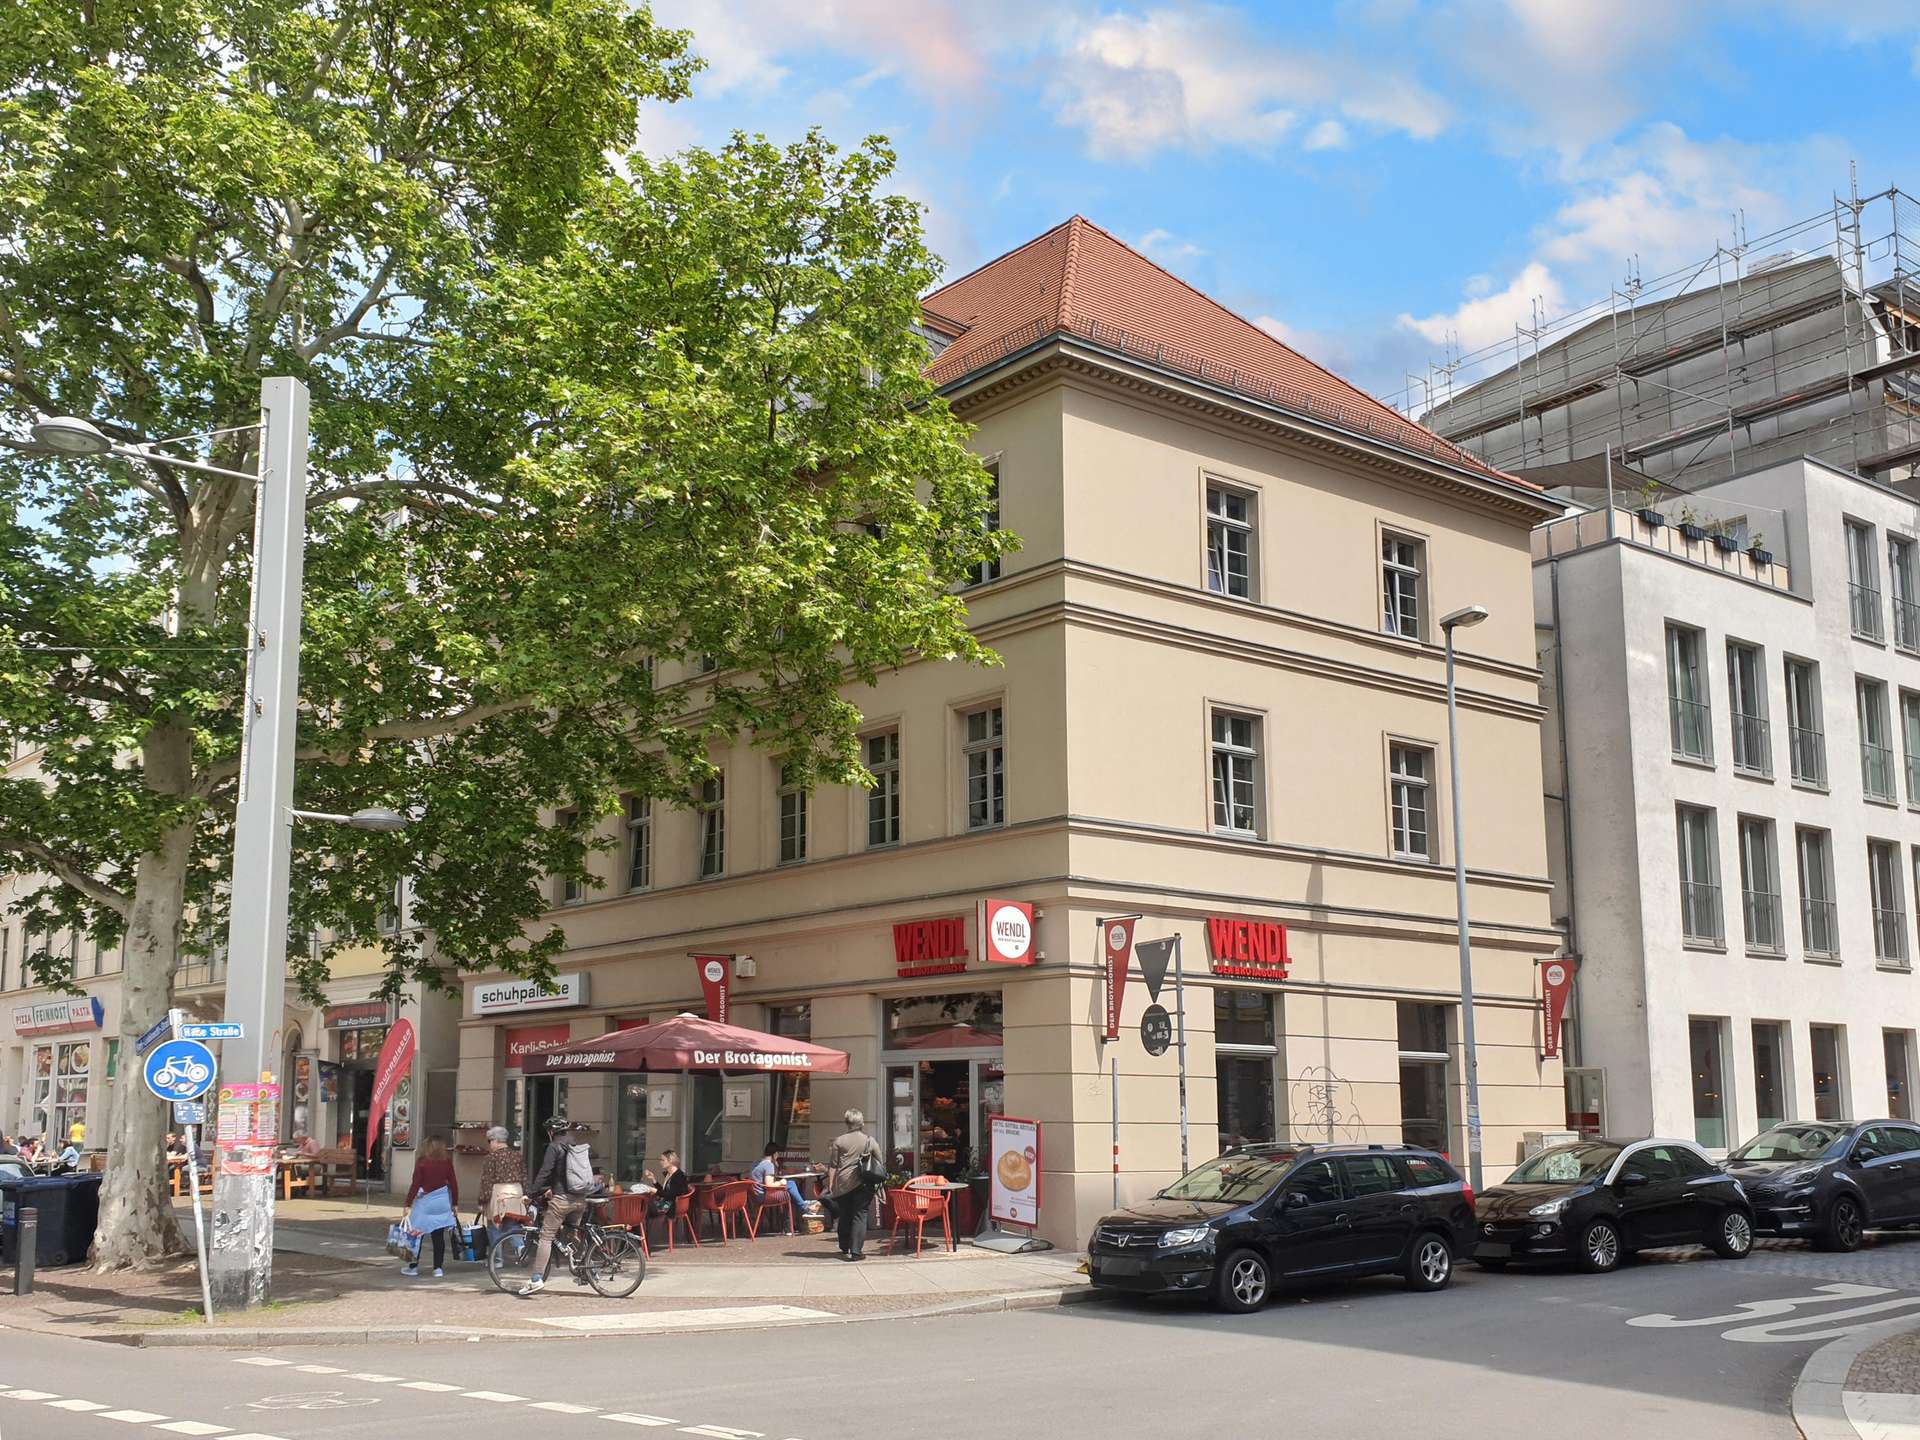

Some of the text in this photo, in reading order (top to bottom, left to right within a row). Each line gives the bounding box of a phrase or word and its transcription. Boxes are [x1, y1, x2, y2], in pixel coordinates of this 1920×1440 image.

[996, 921, 1026, 938] WENDL
[893, 917, 969, 962] WENDL
[1211, 916, 1292, 964] WENDL
[482, 983, 569, 1003] schuhpalee
[16, 1014, 32, 1024] PIZZA
[36, 1006, 66, 1022] FEINKOST
[72, 1007, 90, 1017] PASTA
[209, 1026, 240, 1038] Straße
[546, 1054, 562, 1066] Der
[694, 1050, 812, 1068] Der Brotagonist.
